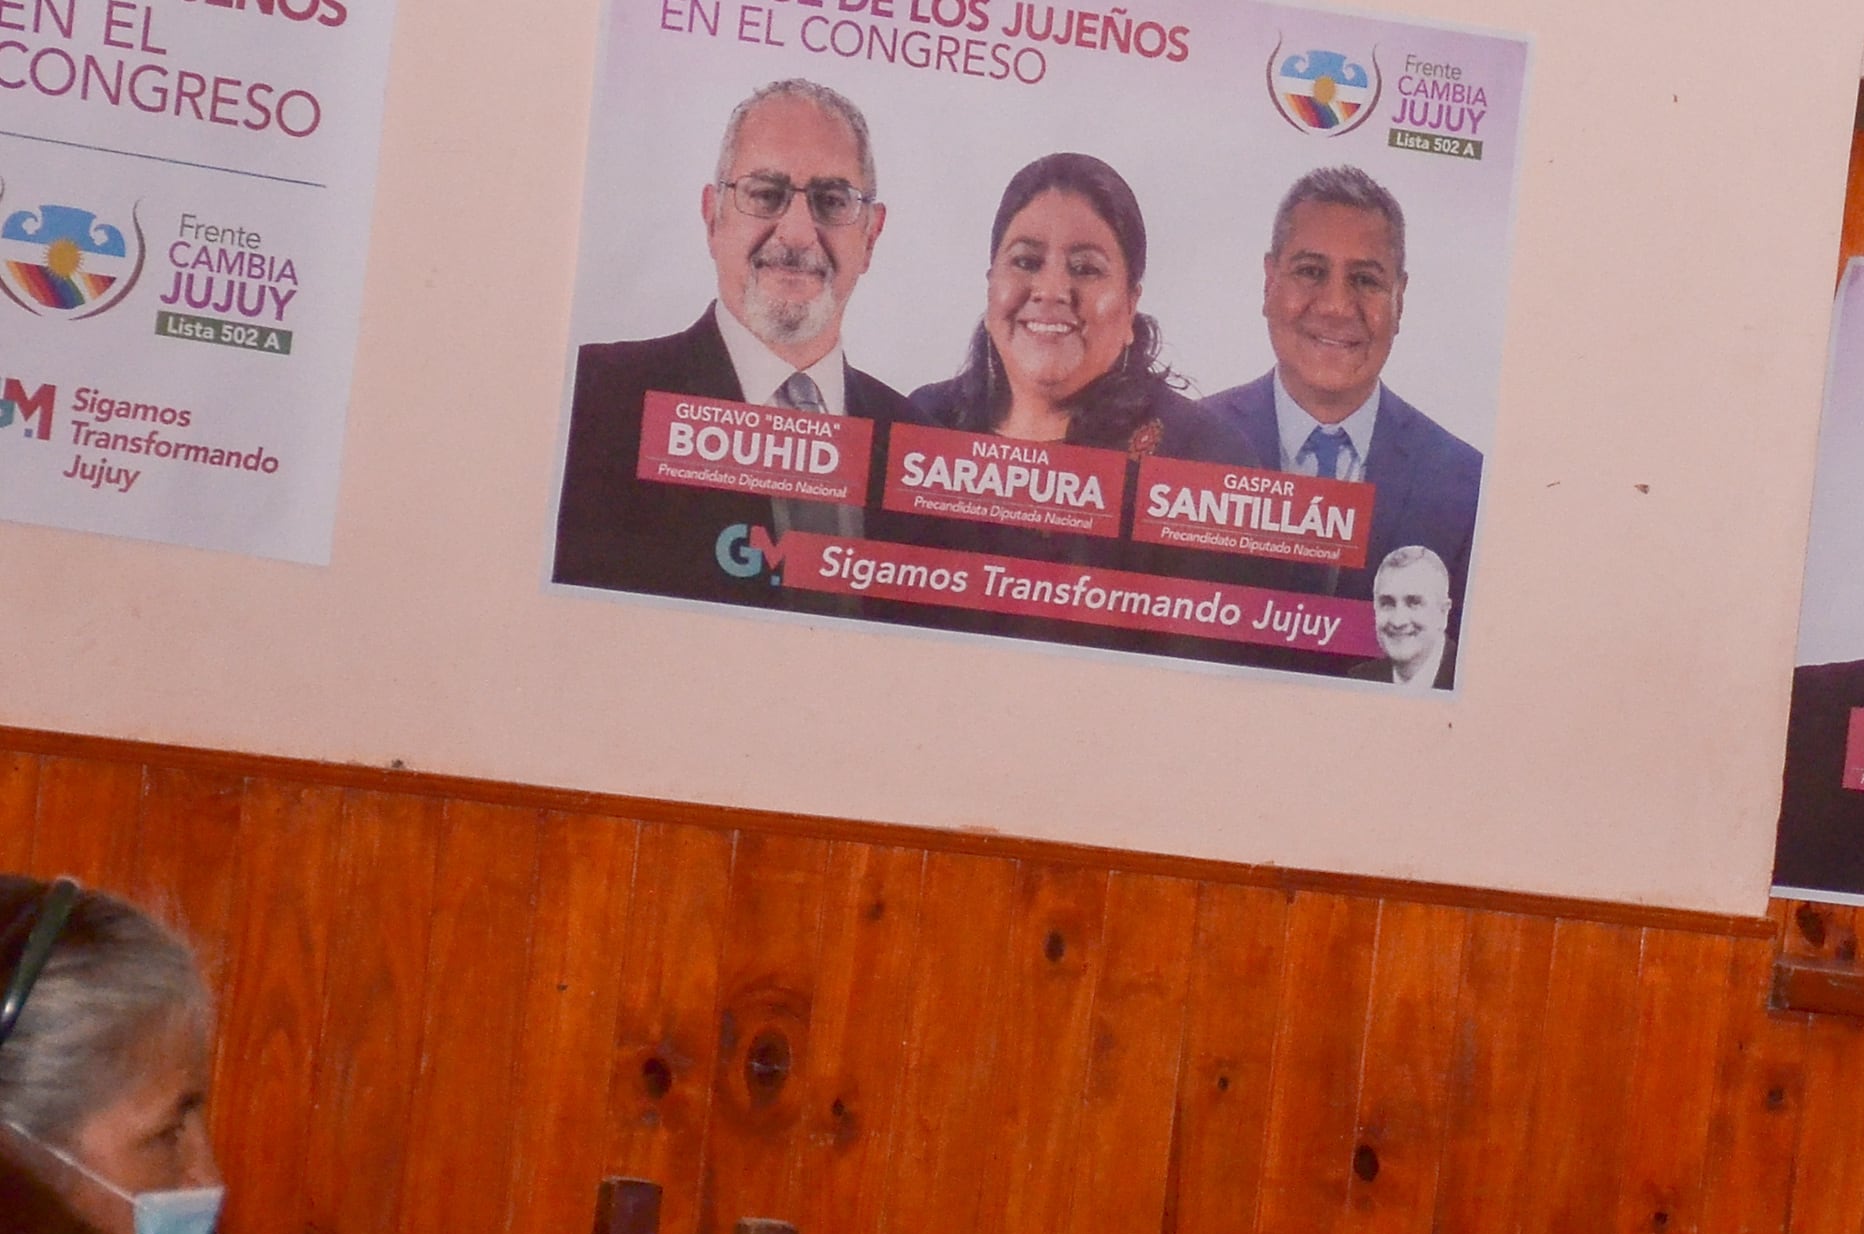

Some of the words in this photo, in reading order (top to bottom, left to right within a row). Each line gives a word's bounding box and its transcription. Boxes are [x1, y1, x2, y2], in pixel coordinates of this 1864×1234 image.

[0, 0, 75, 39] EN
[103, 0, 167, 55] EL
[661, 0, 720, 37] EN
[738, 4, 785, 47] EL
[800, 15, 1046, 84] CONGRESO
[1001, 2, 1190, 62] JUJEÑOS
[1405, 54, 1462, 80] Frente
[0, 40, 321, 137] CONGRESO
[1398, 75, 1487, 107] CAMBIA
[1392, 98, 1486, 135] JUJUY
[1396, 132, 1430, 150] Lista
[1433, 137, 1459, 154] 502
[1463, 142, 1475, 157] A
[179, 213, 262, 250] Frente
[169, 240, 298, 286] CAMBIA
[160, 271, 297, 321] JUJUY
[167, 316, 215, 340] Lista
[221, 324, 259, 346] 502
[264, 332, 281, 350] A
[71, 387, 192, 427] Sigamos
[675, 402, 760, 428] GUSTAVO
[765, 413, 841, 438] "BACHA"
[71, 420, 280, 474] Transformando
[667, 421, 840, 475] BOUHID
[972, 440, 1049, 466] NATALIA
[63, 454, 141, 493] Jujuy
[657, 463, 736, 485] Precandidato
[738, 473, 794, 492] Diputado
[795, 481, 848, 499] Nacional
[901, 452, 1105, 510] SARAPURA
[1223, 473, 1294, 497] GASPAR
[913, 495, 988, 516] Precandidata
[990, 505, 1042, 525] Diputada
[1043, 511, 1093, 530] Nacional
[1147, 483, 1356, 541] SANTILLÁN
[1160, 526, 1237, 548] Precandidato
[1239, 536, 1292, 556] Diputado
[1293, 543, 1341, 561] Nacional
[819, 545, 969, 591] Sigamos
[982, 564, 1242, 629] Transformando
[1251, 599, 1342, 645] Jujuy
